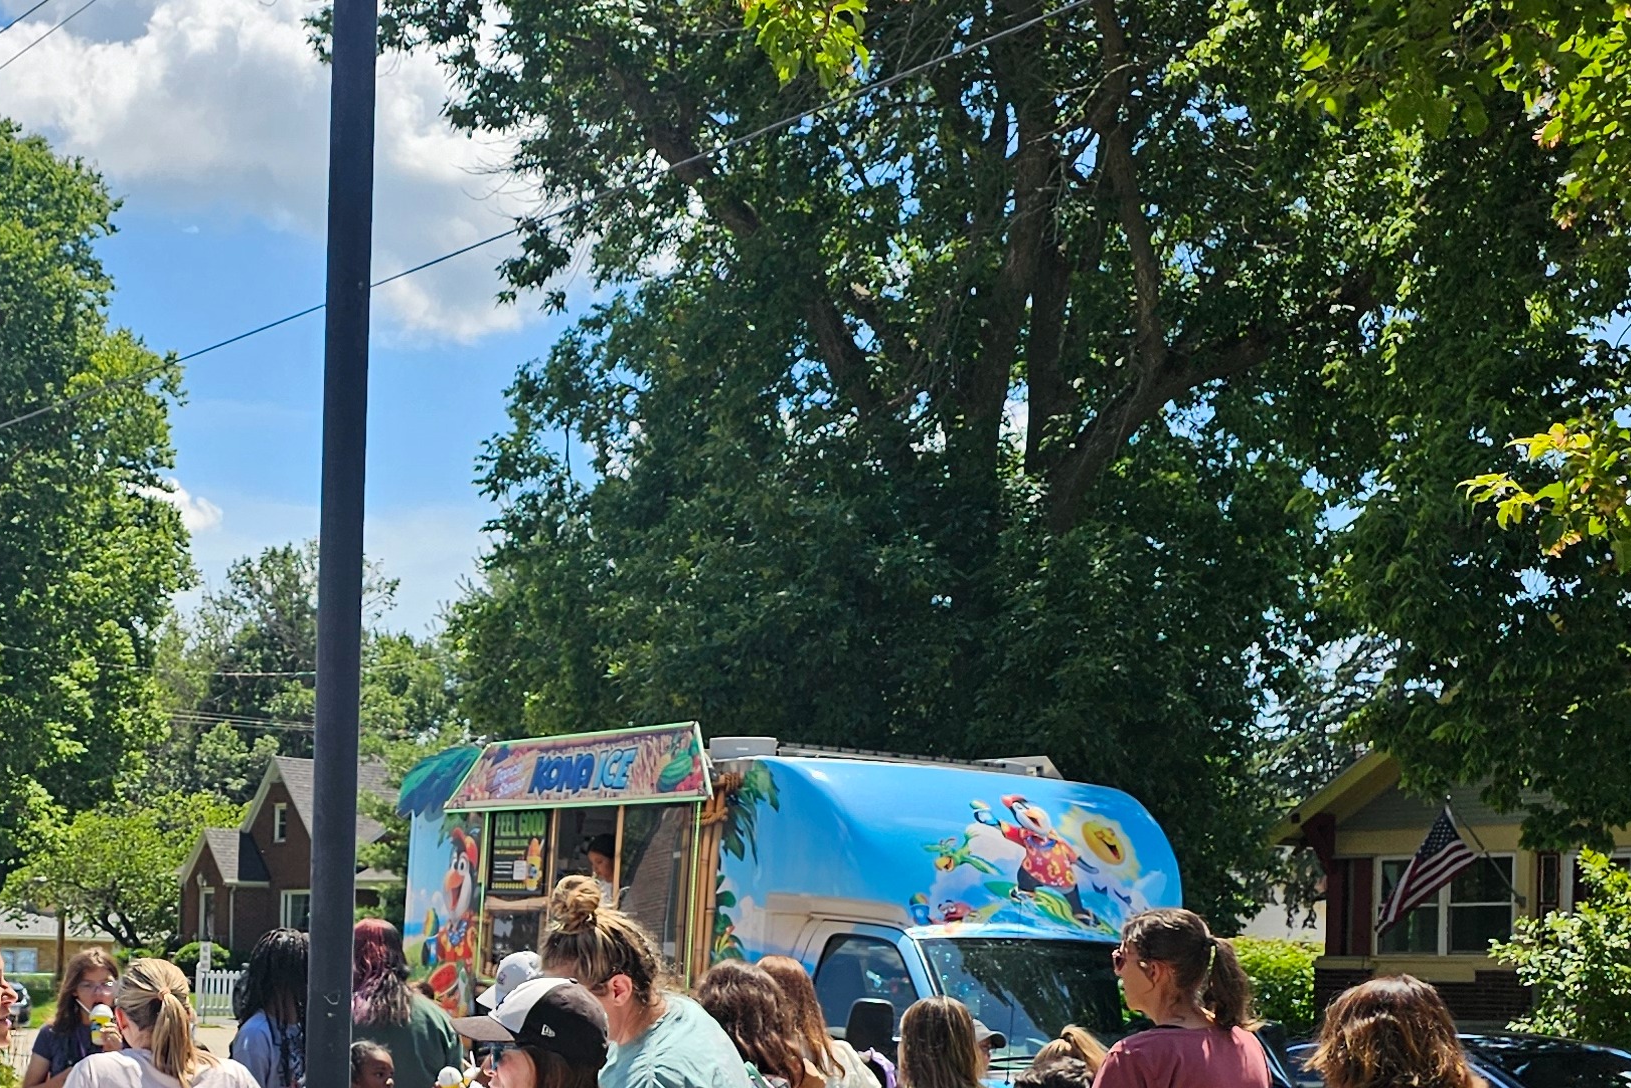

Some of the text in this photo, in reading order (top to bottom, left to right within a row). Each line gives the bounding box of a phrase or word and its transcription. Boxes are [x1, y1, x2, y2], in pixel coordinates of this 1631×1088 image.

[527, 745, 639, 795] KONA ICE
[495, 811, 545, 837] FEEL GOOD
